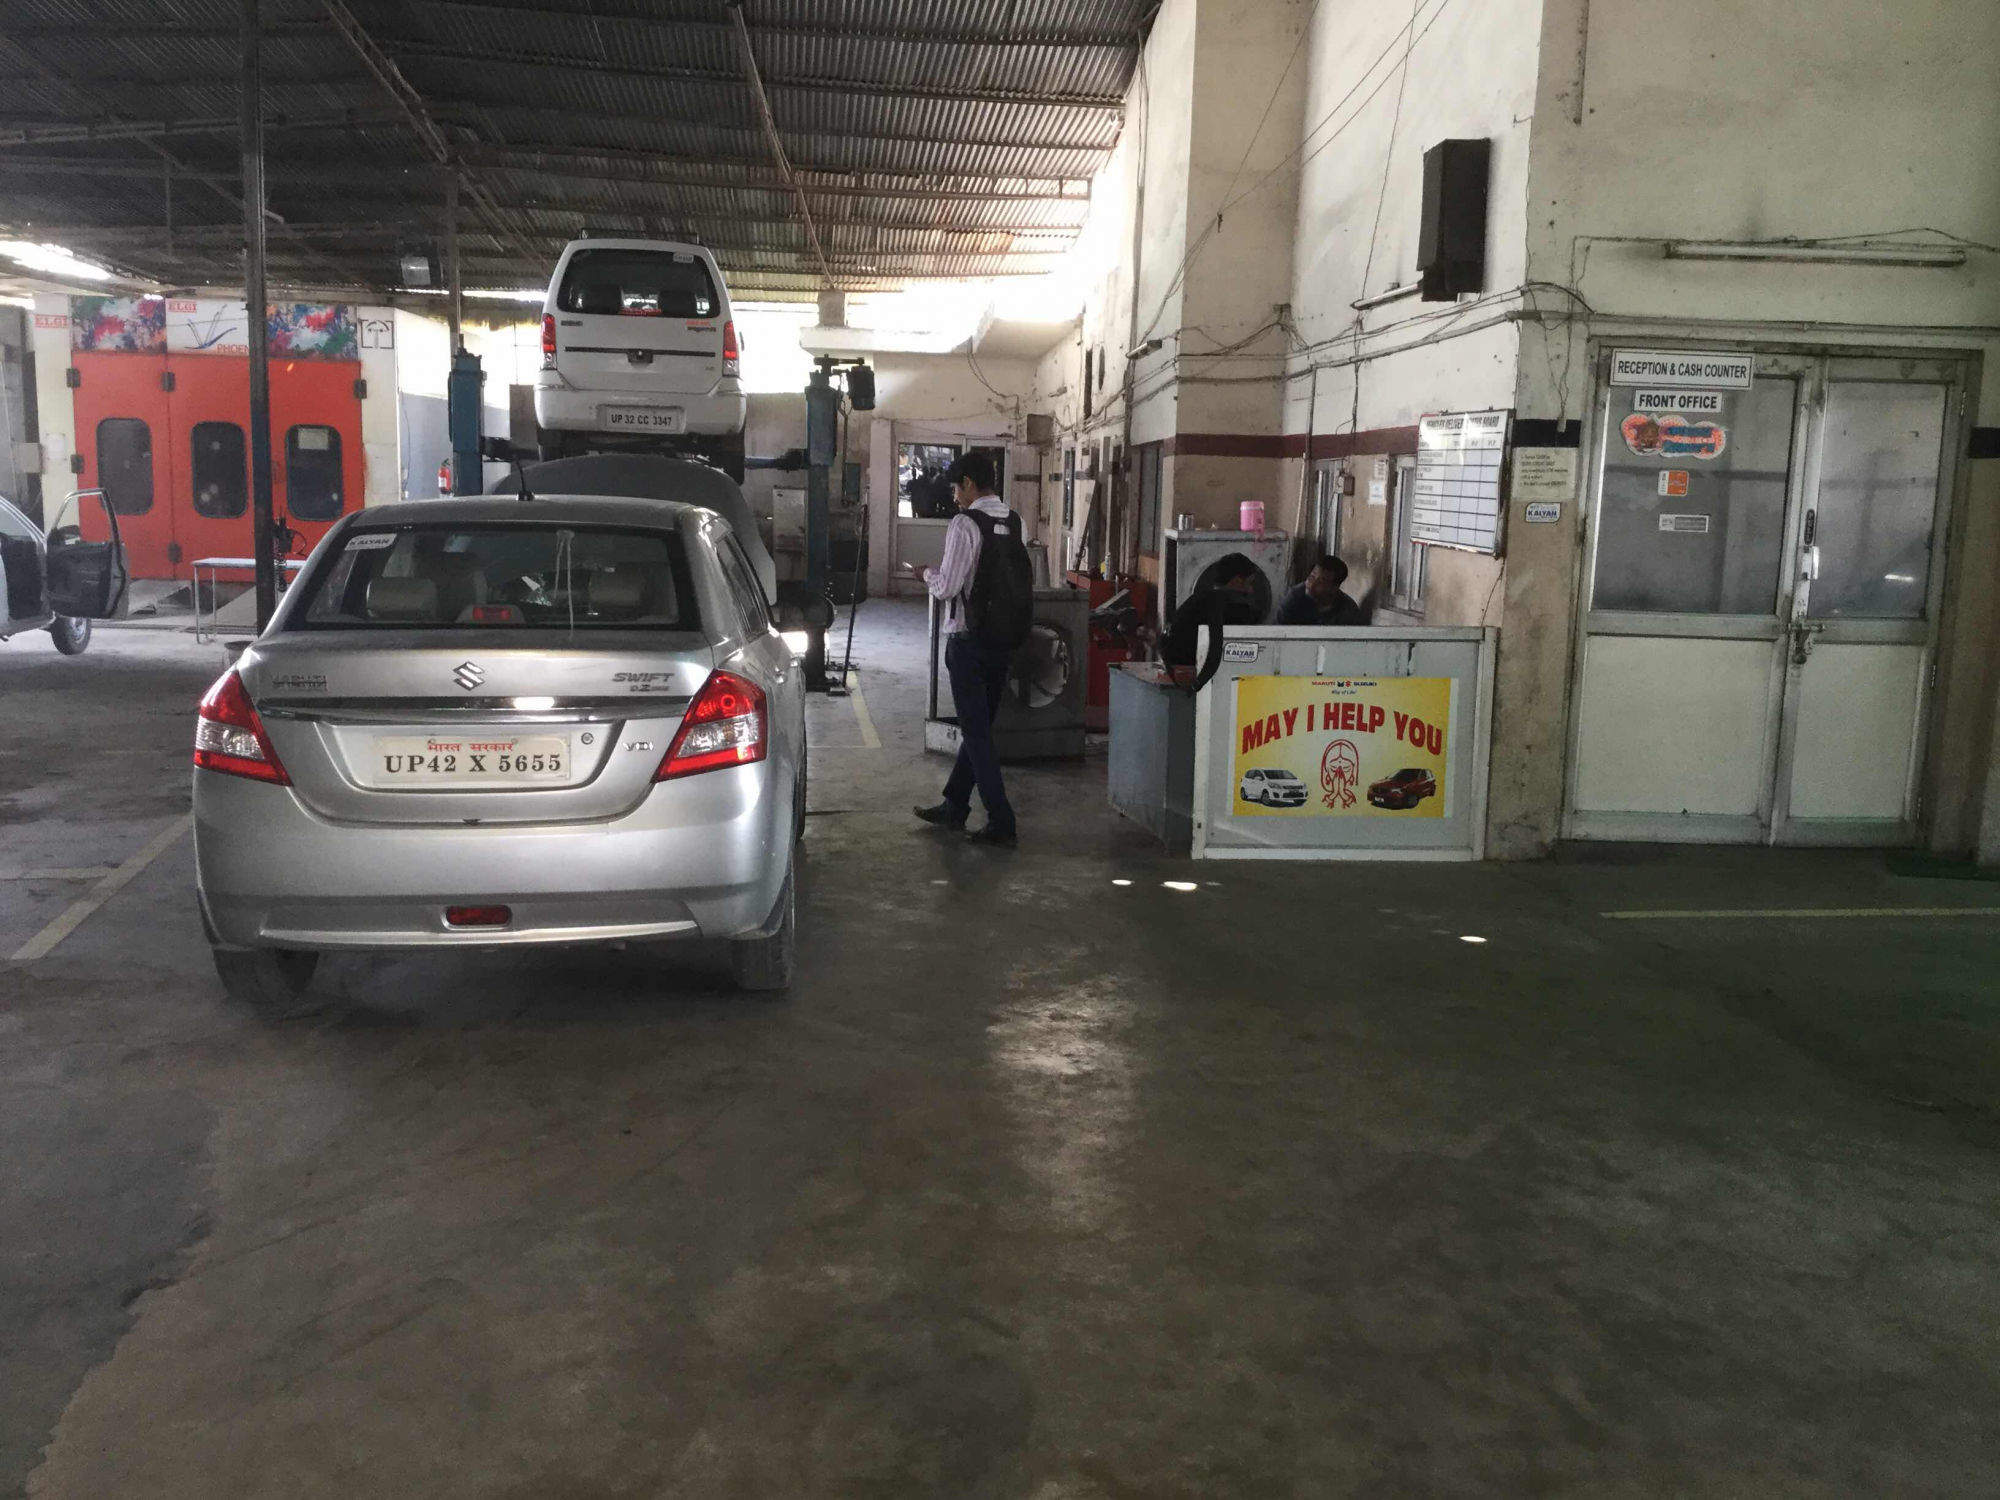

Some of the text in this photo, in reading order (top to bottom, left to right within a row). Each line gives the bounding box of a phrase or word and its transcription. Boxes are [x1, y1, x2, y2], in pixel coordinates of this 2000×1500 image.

[1617, 360, 1747, 379] RECEPTION & CASH COUNTER
[1638, 394, 1718, 409] FRONT OFFICE
[611, 414, 623, 423] UP
[625, 415, 635, 424] 32
[637, 415, 649, 425] CC
[1225, 649, 1255, 657] KALYAN
[612, 672, 675, 683] SWIFT
[1242, 702, 1443, 756] MAY I HELP YOU
[384, 753, 562, 773] UP42 X 5655
